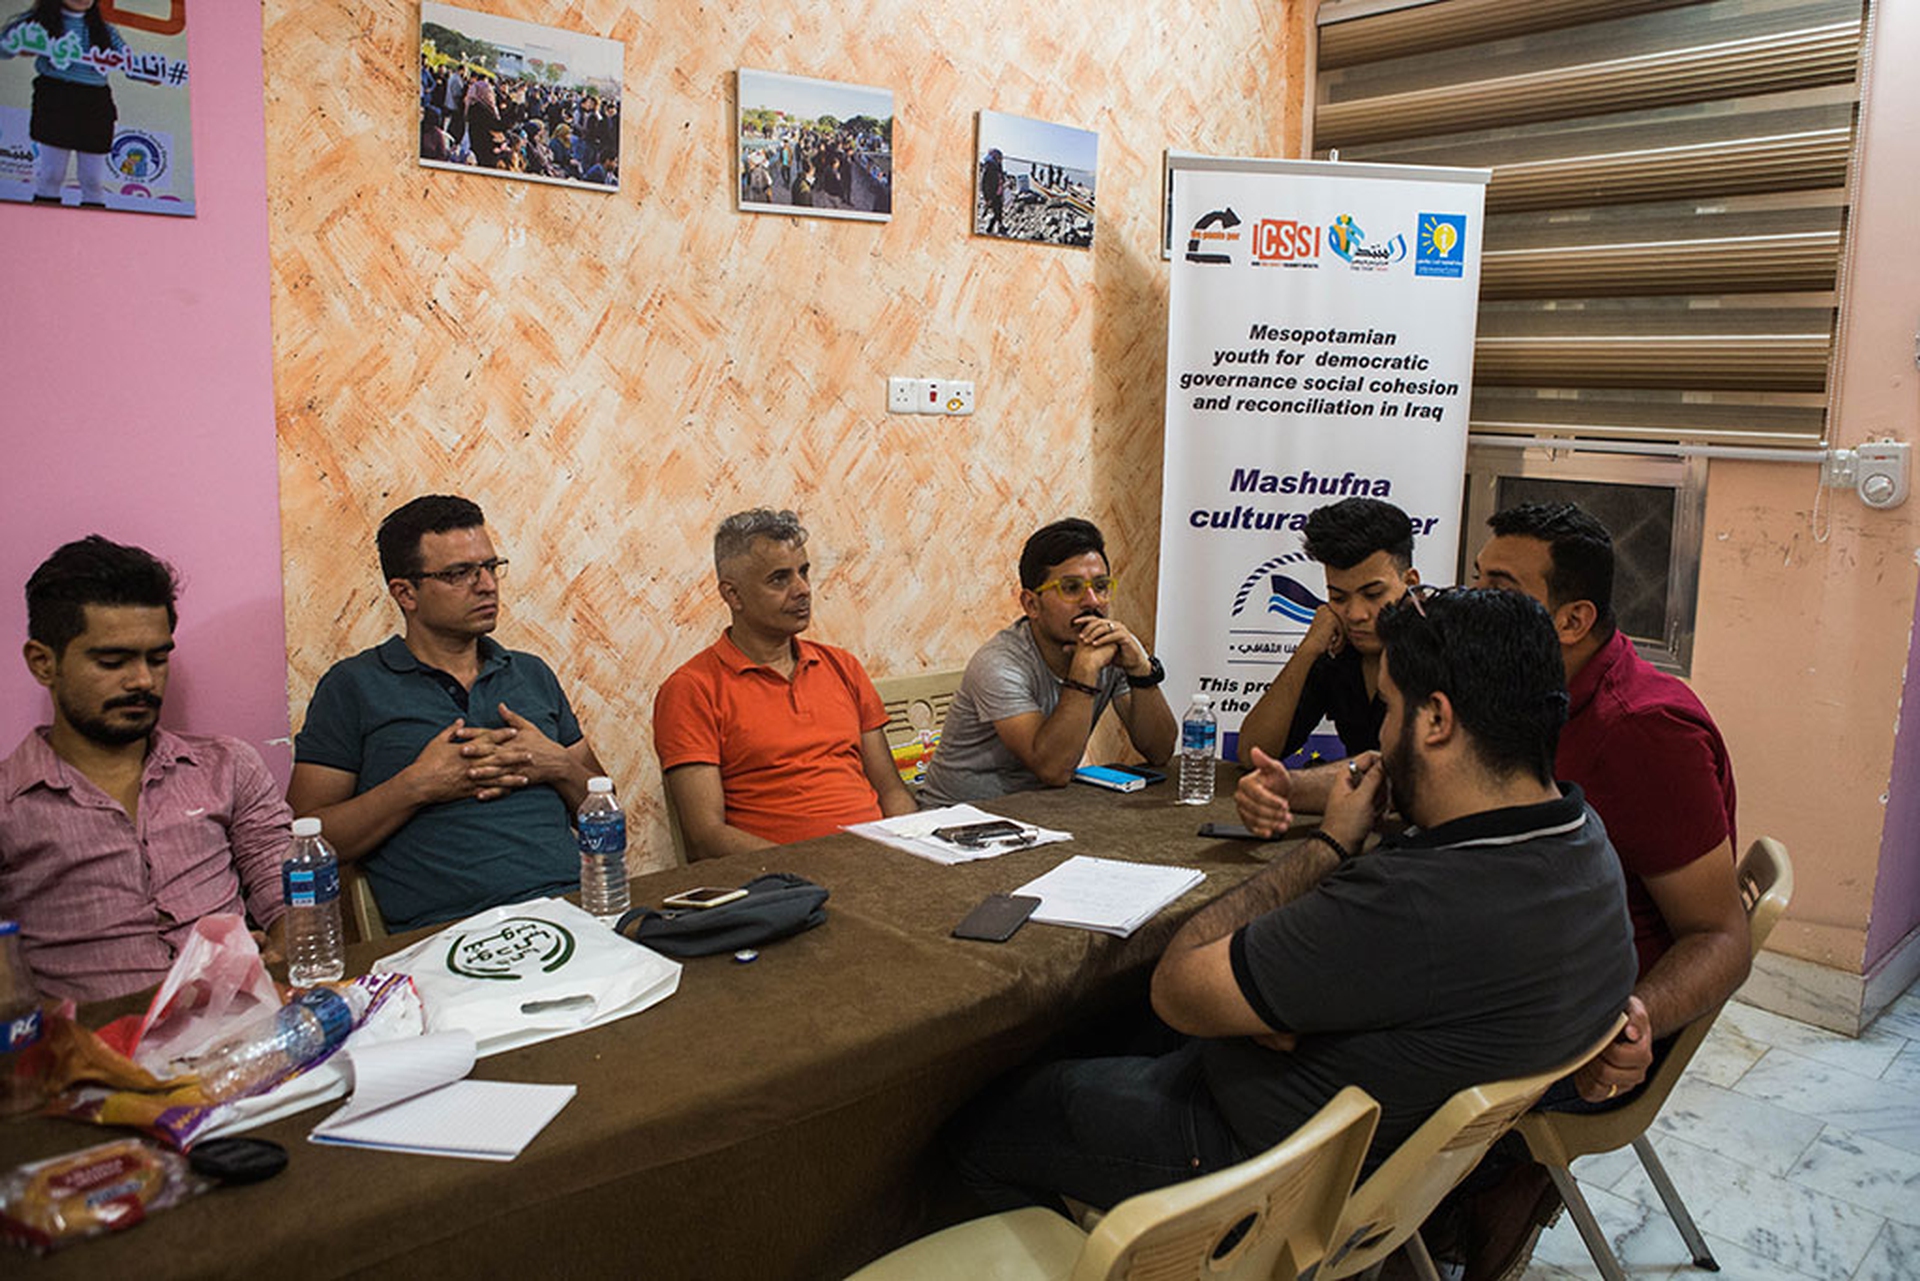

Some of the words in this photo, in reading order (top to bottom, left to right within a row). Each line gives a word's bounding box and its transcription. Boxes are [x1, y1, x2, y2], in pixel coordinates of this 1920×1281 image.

[1252, 221, 1321, 259] ICSSI
[1249, 324, 1397, 346] Mesopotamian
[1212, 348, 1270, 367] youth
[1275, 349, 1305, 367] for
[1315, 351, 1429, 371] democratic
[1179, 373, 1298, 390] governance
[1303, 375, 1364, 393] social
[1369, 377, 1459, 396] cohesion
[1192, 395, 1232, 411] and
[1236, 397, 1375, 416] reconciliation
[1380, 400, 1399, 417] in
[1404, 402, 1444, 423] Iraq
[1229, 468, 1392, 498] Mashufna
[1189, 505, 1308, 532] cultura
[1199, 677, 1240, 693] This
[1242, 682, 1273, 695] pro
[1220, 699, 1251, 713] the
